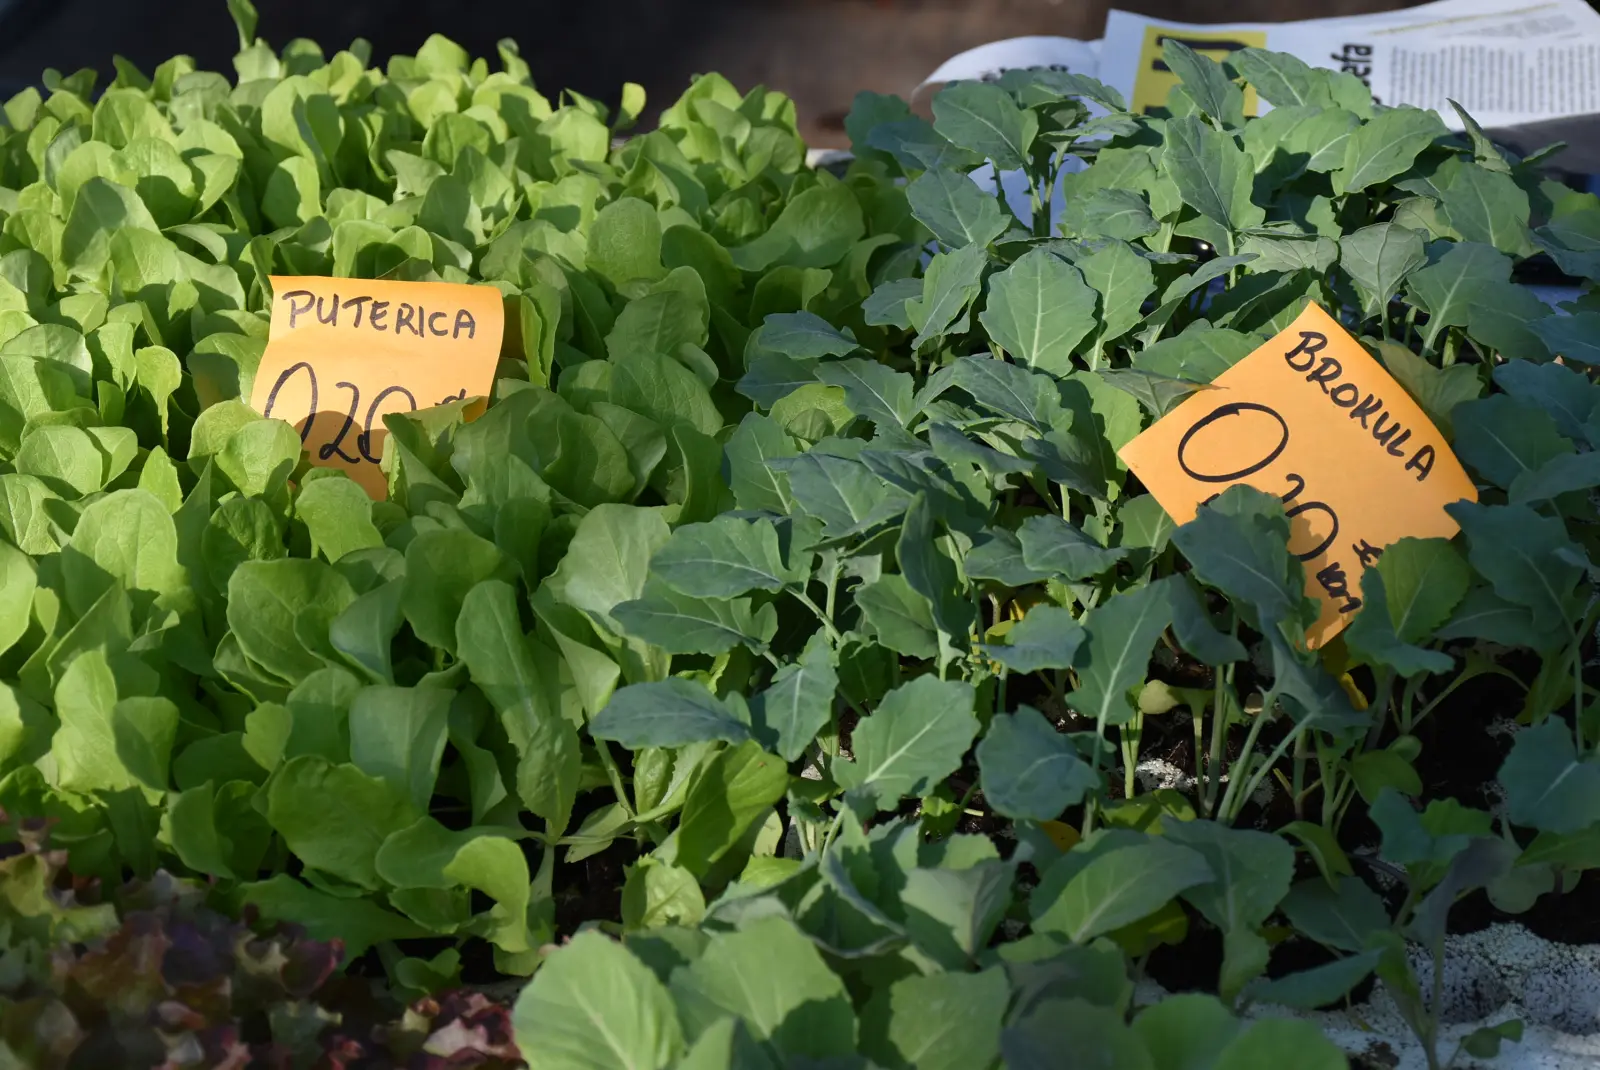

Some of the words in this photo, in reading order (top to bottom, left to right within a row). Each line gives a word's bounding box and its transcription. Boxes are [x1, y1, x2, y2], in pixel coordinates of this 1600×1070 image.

[1330, 43, 1373, 88] efa
[281, 289, 476, 340] PUTERICA
[1284, 330, 1436, 482] BROKULA
